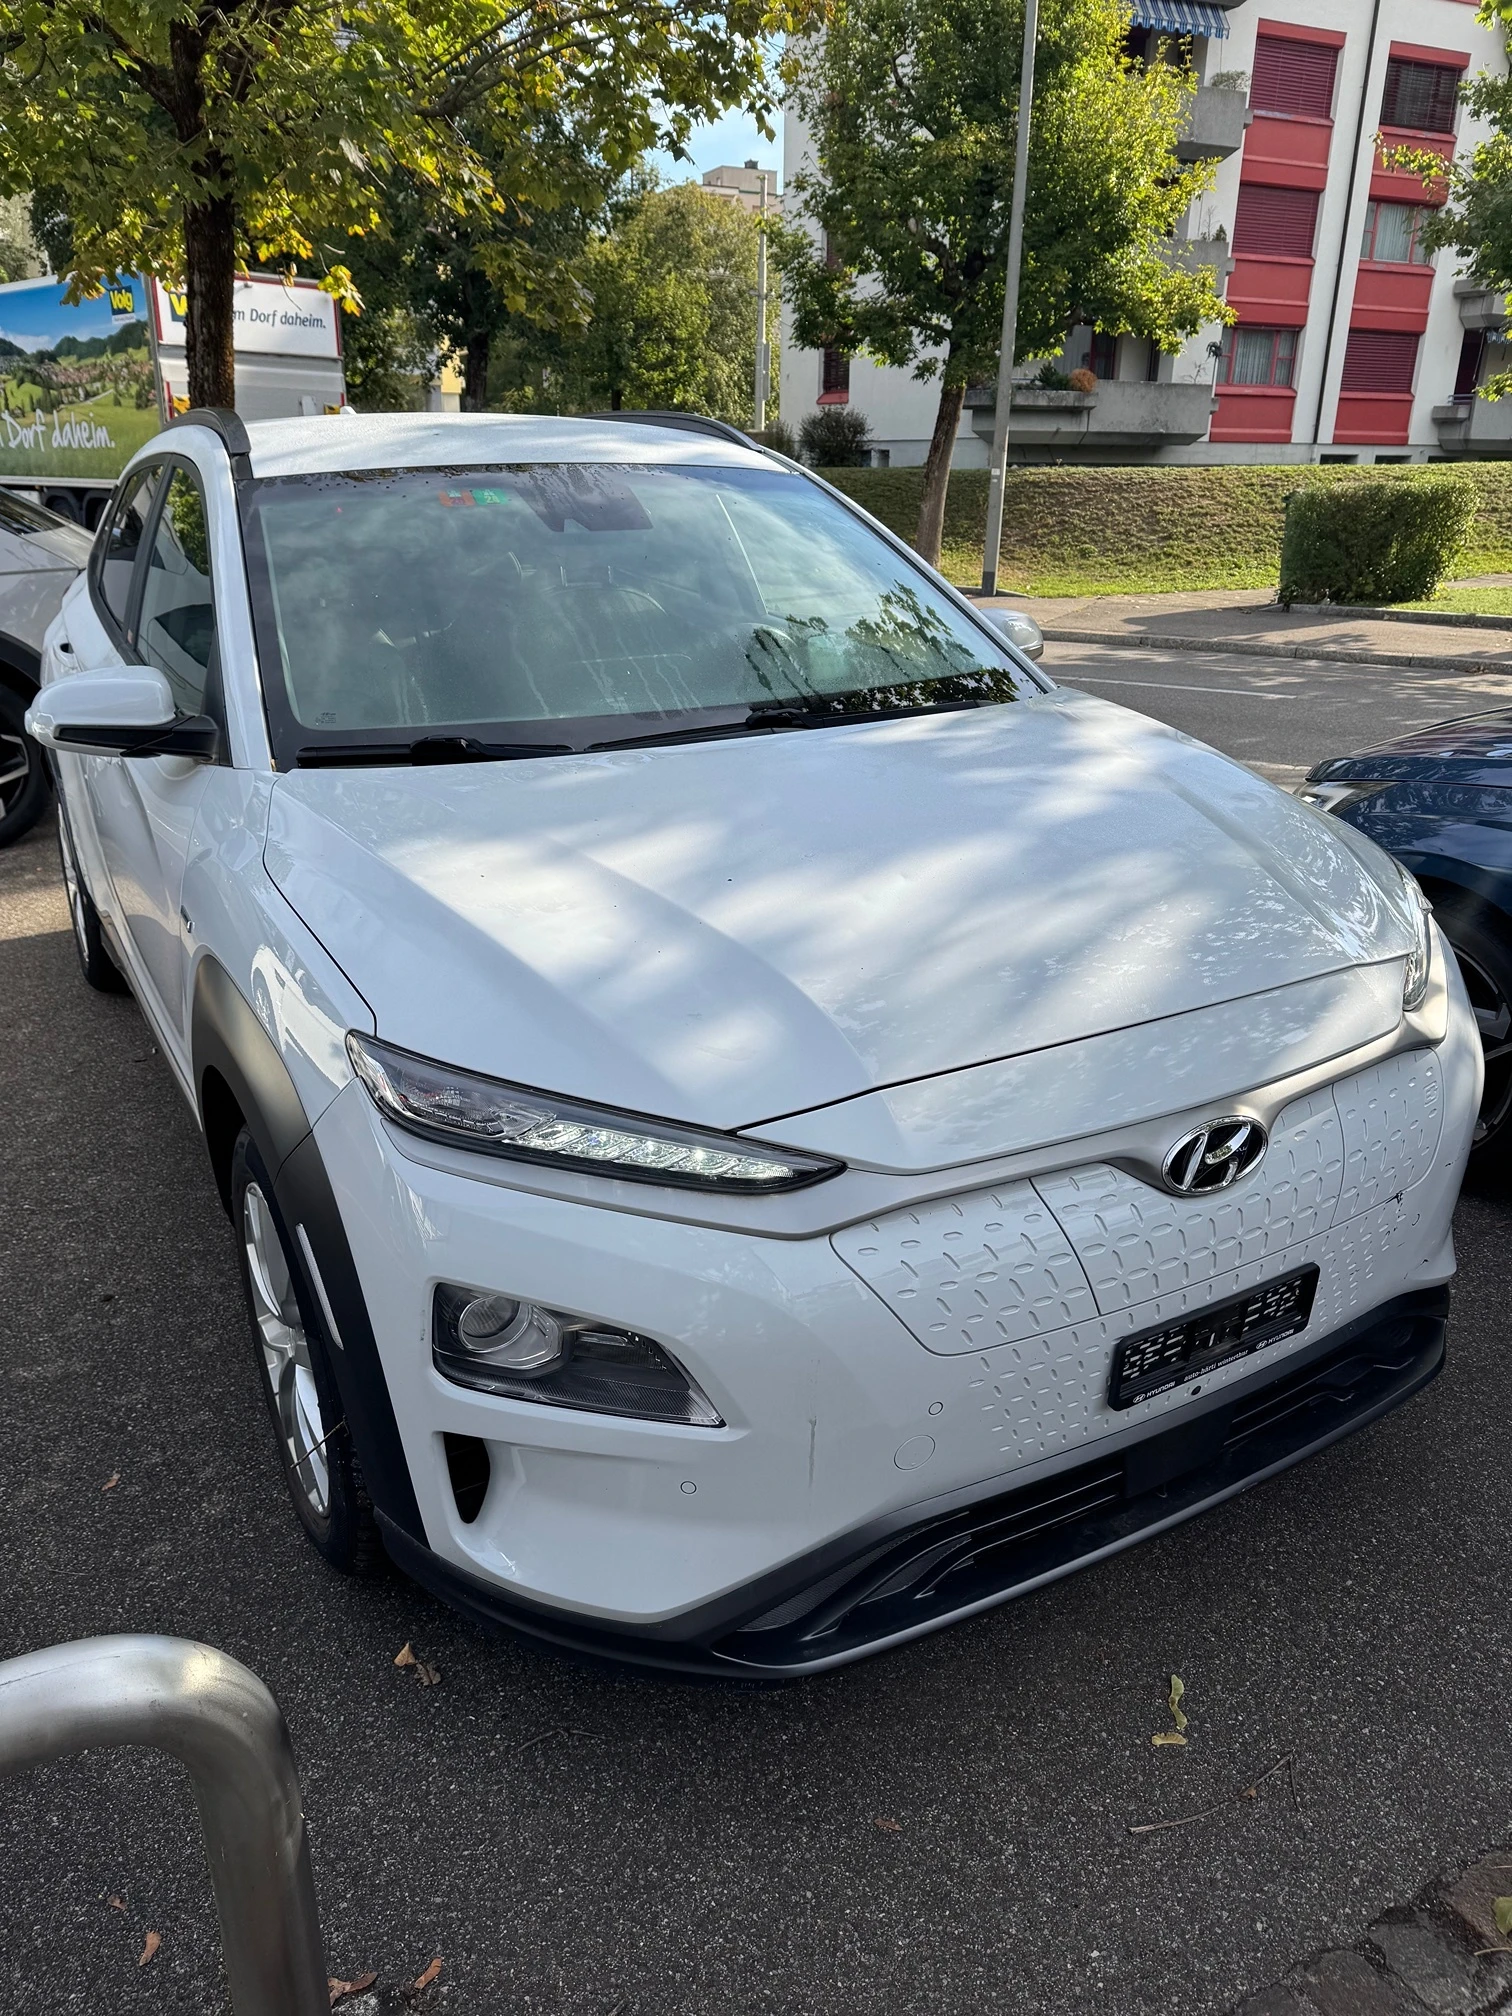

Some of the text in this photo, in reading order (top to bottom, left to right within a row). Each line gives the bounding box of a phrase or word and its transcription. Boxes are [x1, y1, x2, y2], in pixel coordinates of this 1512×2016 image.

[110, 288, 133, 312] Volg
[250, 308, 278, 328] Dorf
[280, 310, 326, 329] daheim.
[1, 408, 46, 452] Dorf
[52, 409, 115, 449] daheim.
[1267, 1328, 1295, 1344] HYUNDAI
[1217, 1349, 1249, 1367] winterthur
[1146, 1380, 1176, 1398] HYUNDAI
